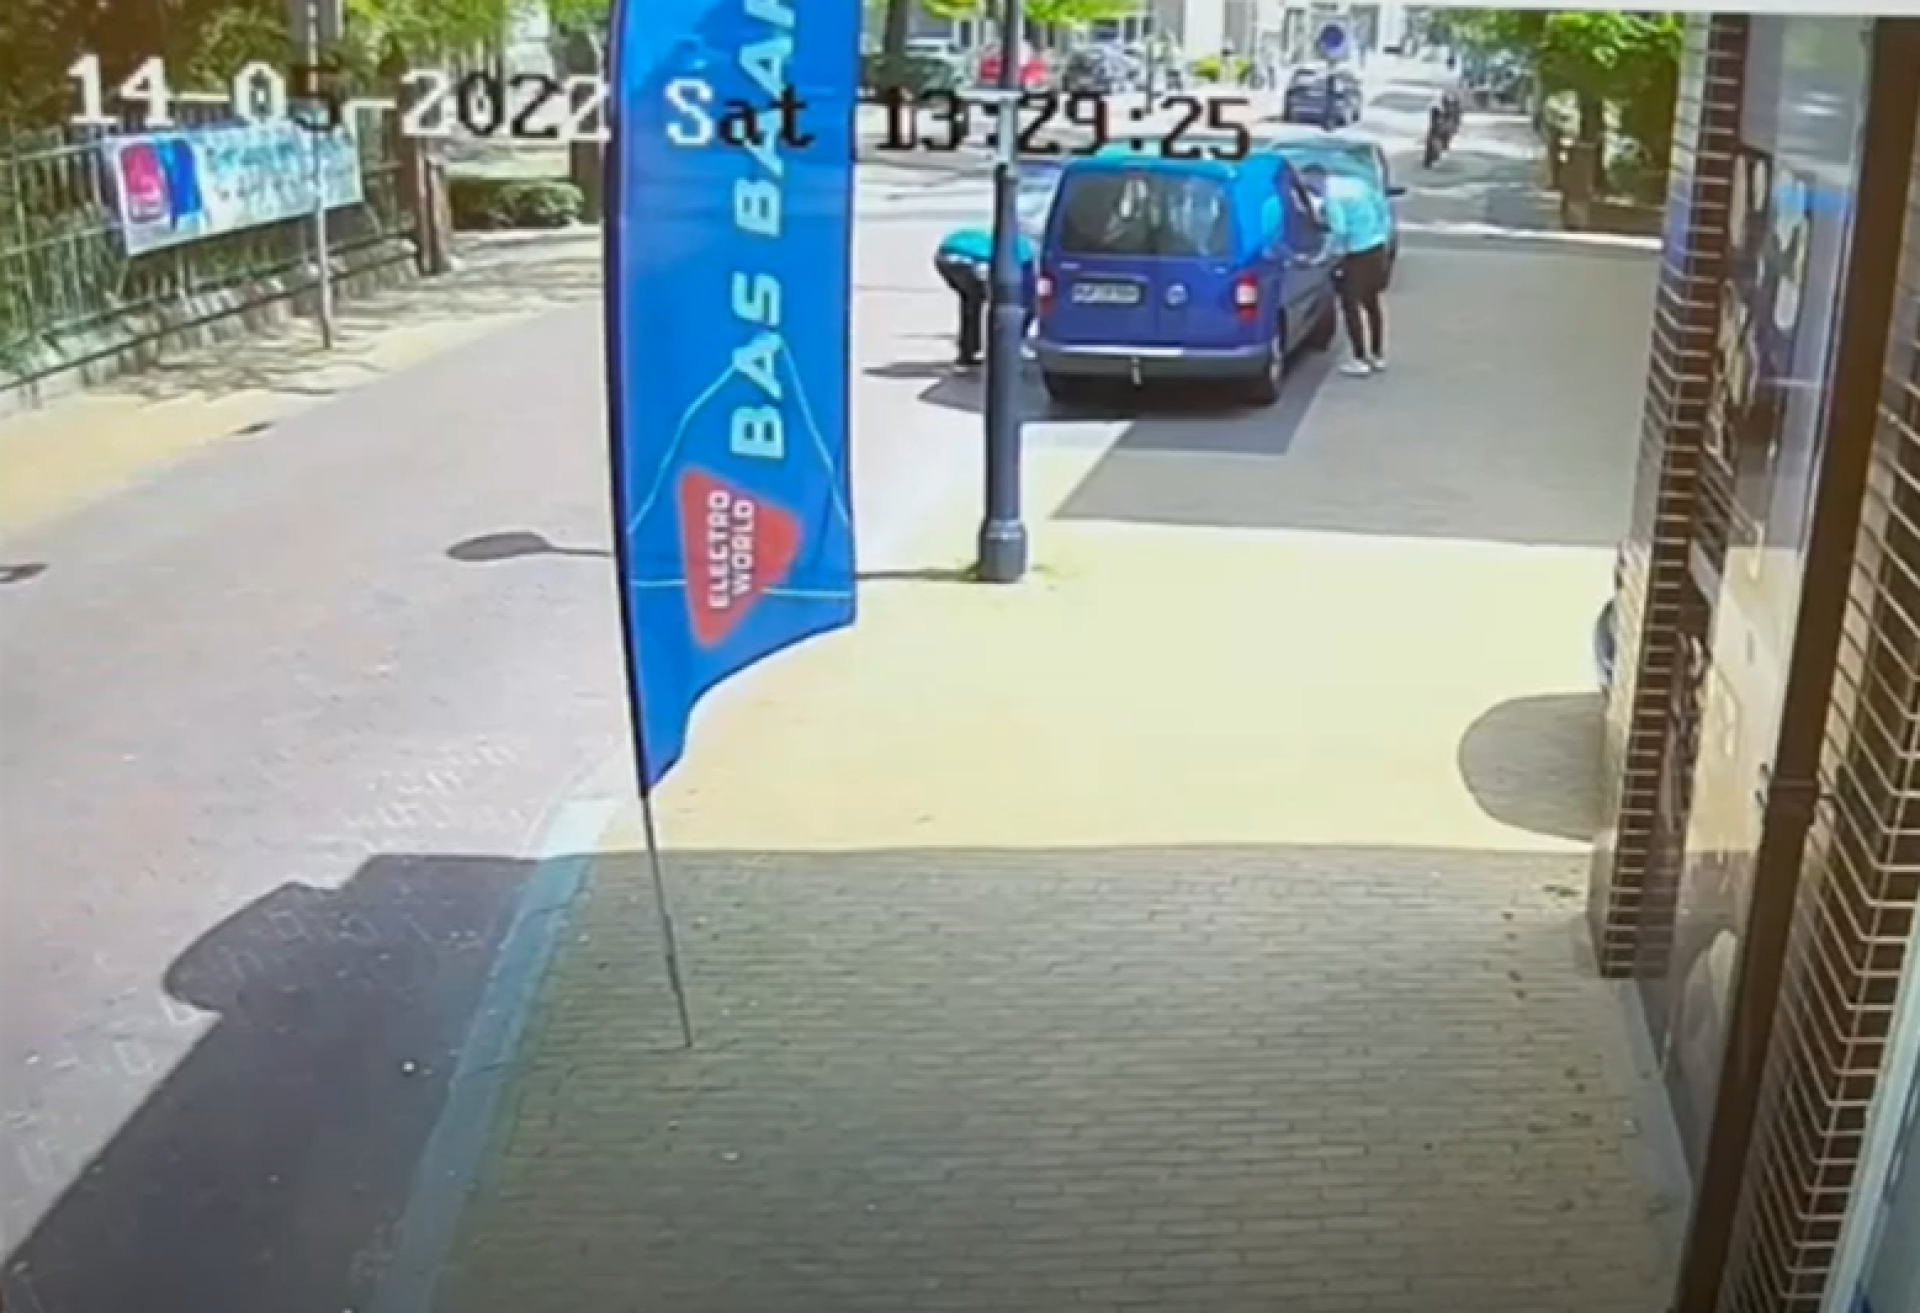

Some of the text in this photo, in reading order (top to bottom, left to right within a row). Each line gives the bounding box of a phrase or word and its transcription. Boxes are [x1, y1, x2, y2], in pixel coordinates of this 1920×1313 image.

[731, 271, 785, 460] BAS
[707, 489, 731, 609] ELECTRO
[731, 499, 755, 596] WORLD
